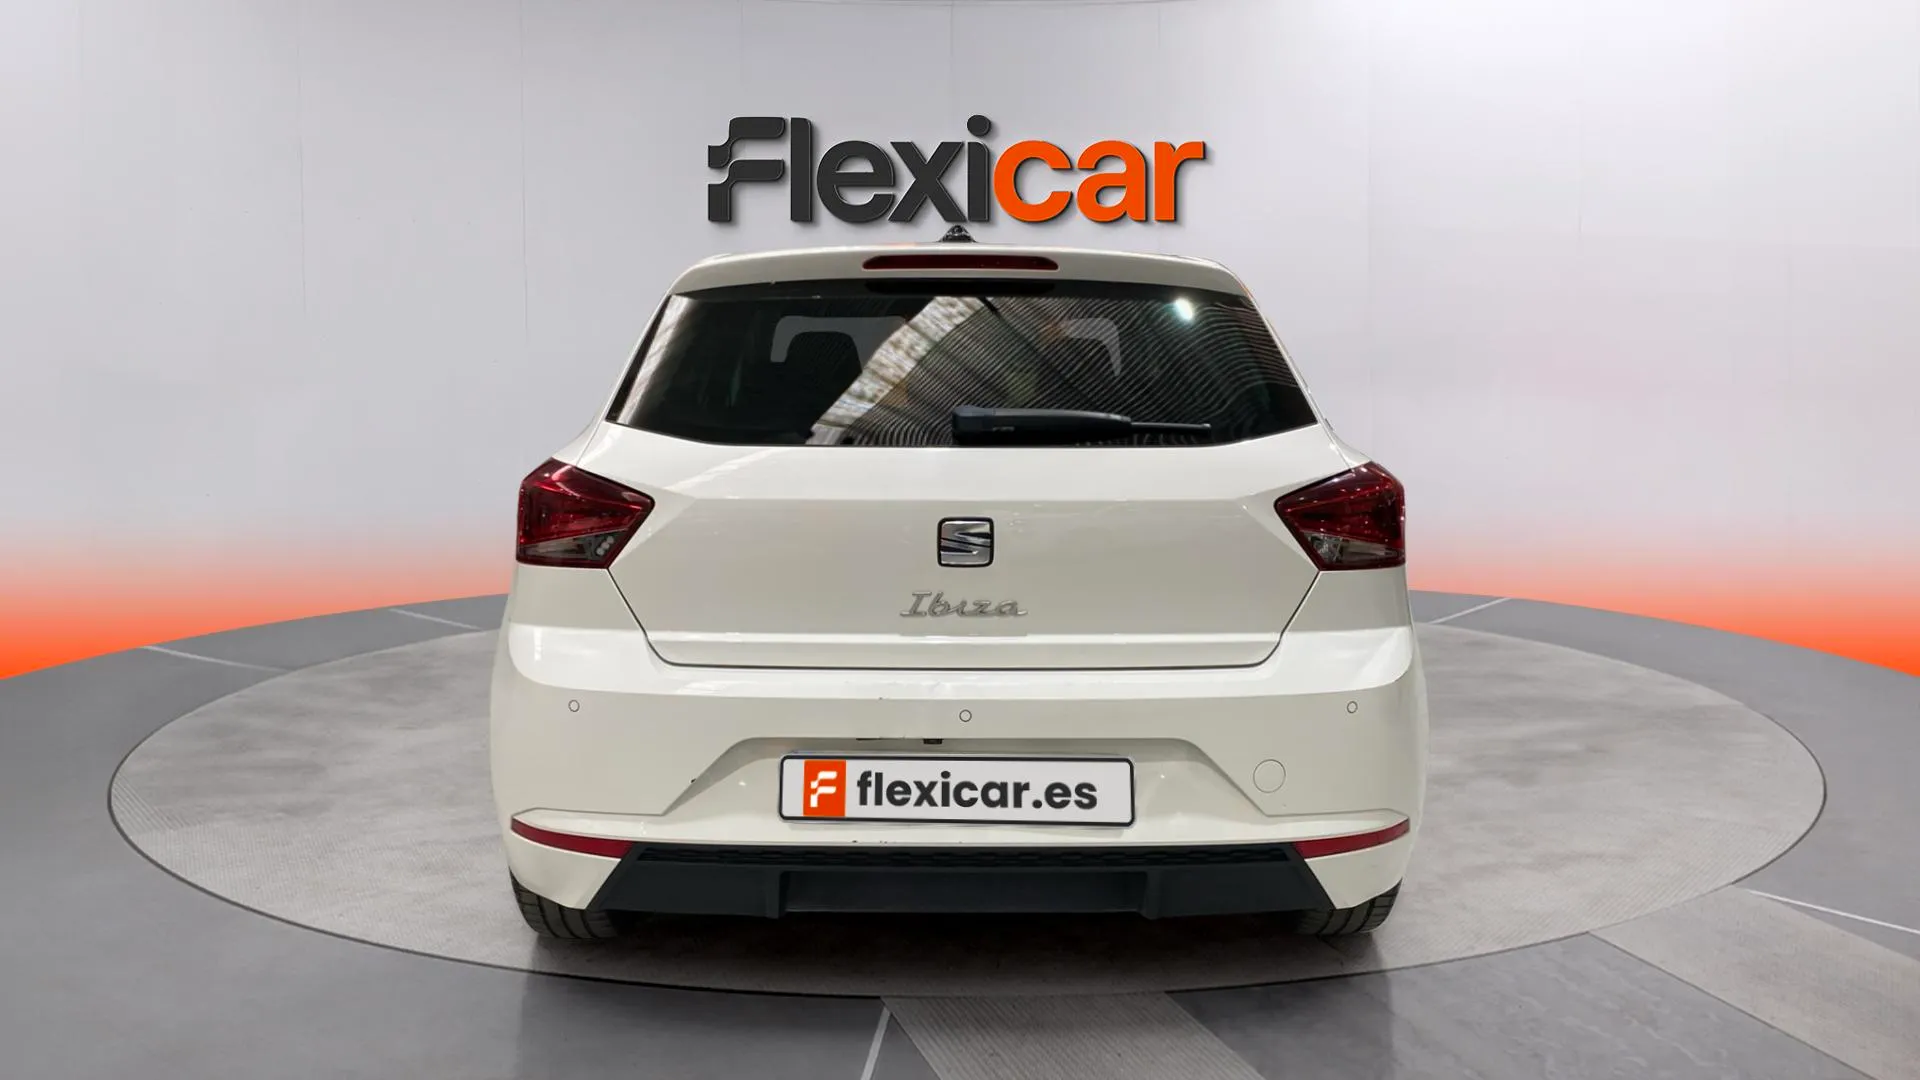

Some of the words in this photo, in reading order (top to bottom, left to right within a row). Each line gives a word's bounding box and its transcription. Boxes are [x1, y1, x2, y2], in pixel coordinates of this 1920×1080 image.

[708, 115, 1205, 222] Flexicar
[900, 591, 1028, 617] Ibiza
[857, 770, 1098, 810] flexicar.es
